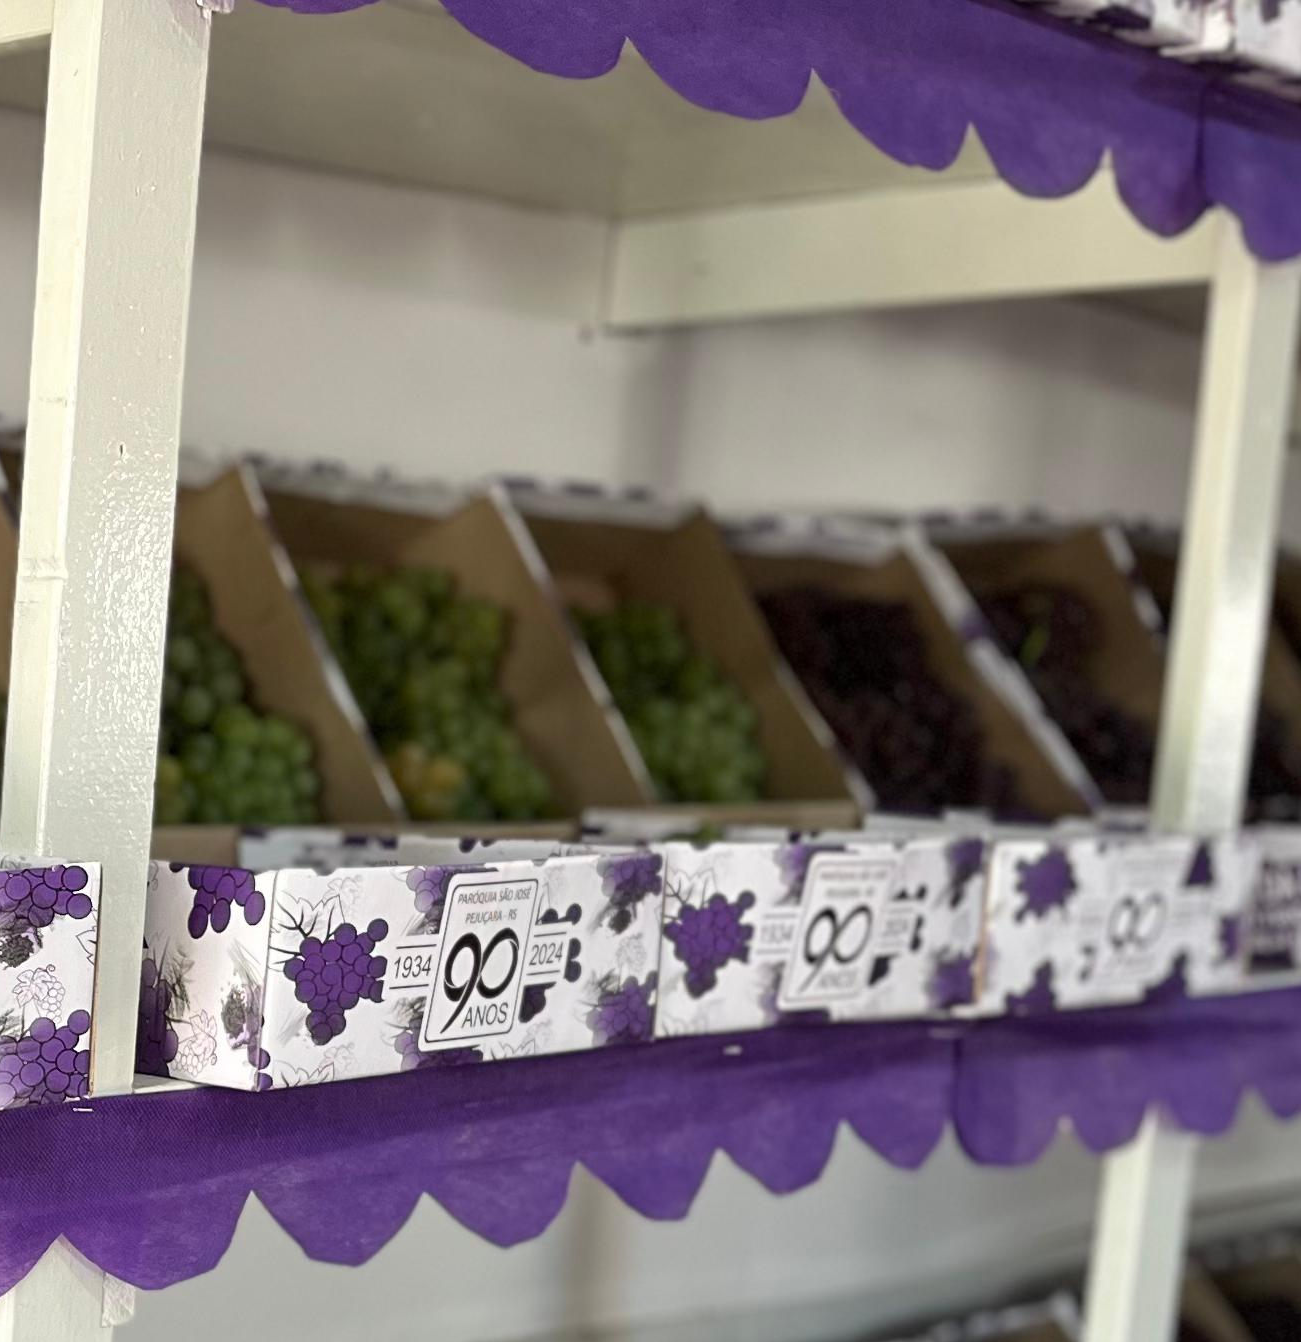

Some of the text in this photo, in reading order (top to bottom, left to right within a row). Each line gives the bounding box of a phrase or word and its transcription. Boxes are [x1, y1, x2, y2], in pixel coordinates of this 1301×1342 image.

[458, 885, 532, 904] PARÓQUIA SÃO JOSÉ
[465, 910, 502, 925] PEJUÇARA
[508, 908, 518, 921] RS
[529, 941, 564, 967] 2024
[800, 902, 873, 993] 90
[394, 954, 432, 979] 1934
[440, 927, 520, 1034] 90
[461, 1002, 509, 1029] ANOS
